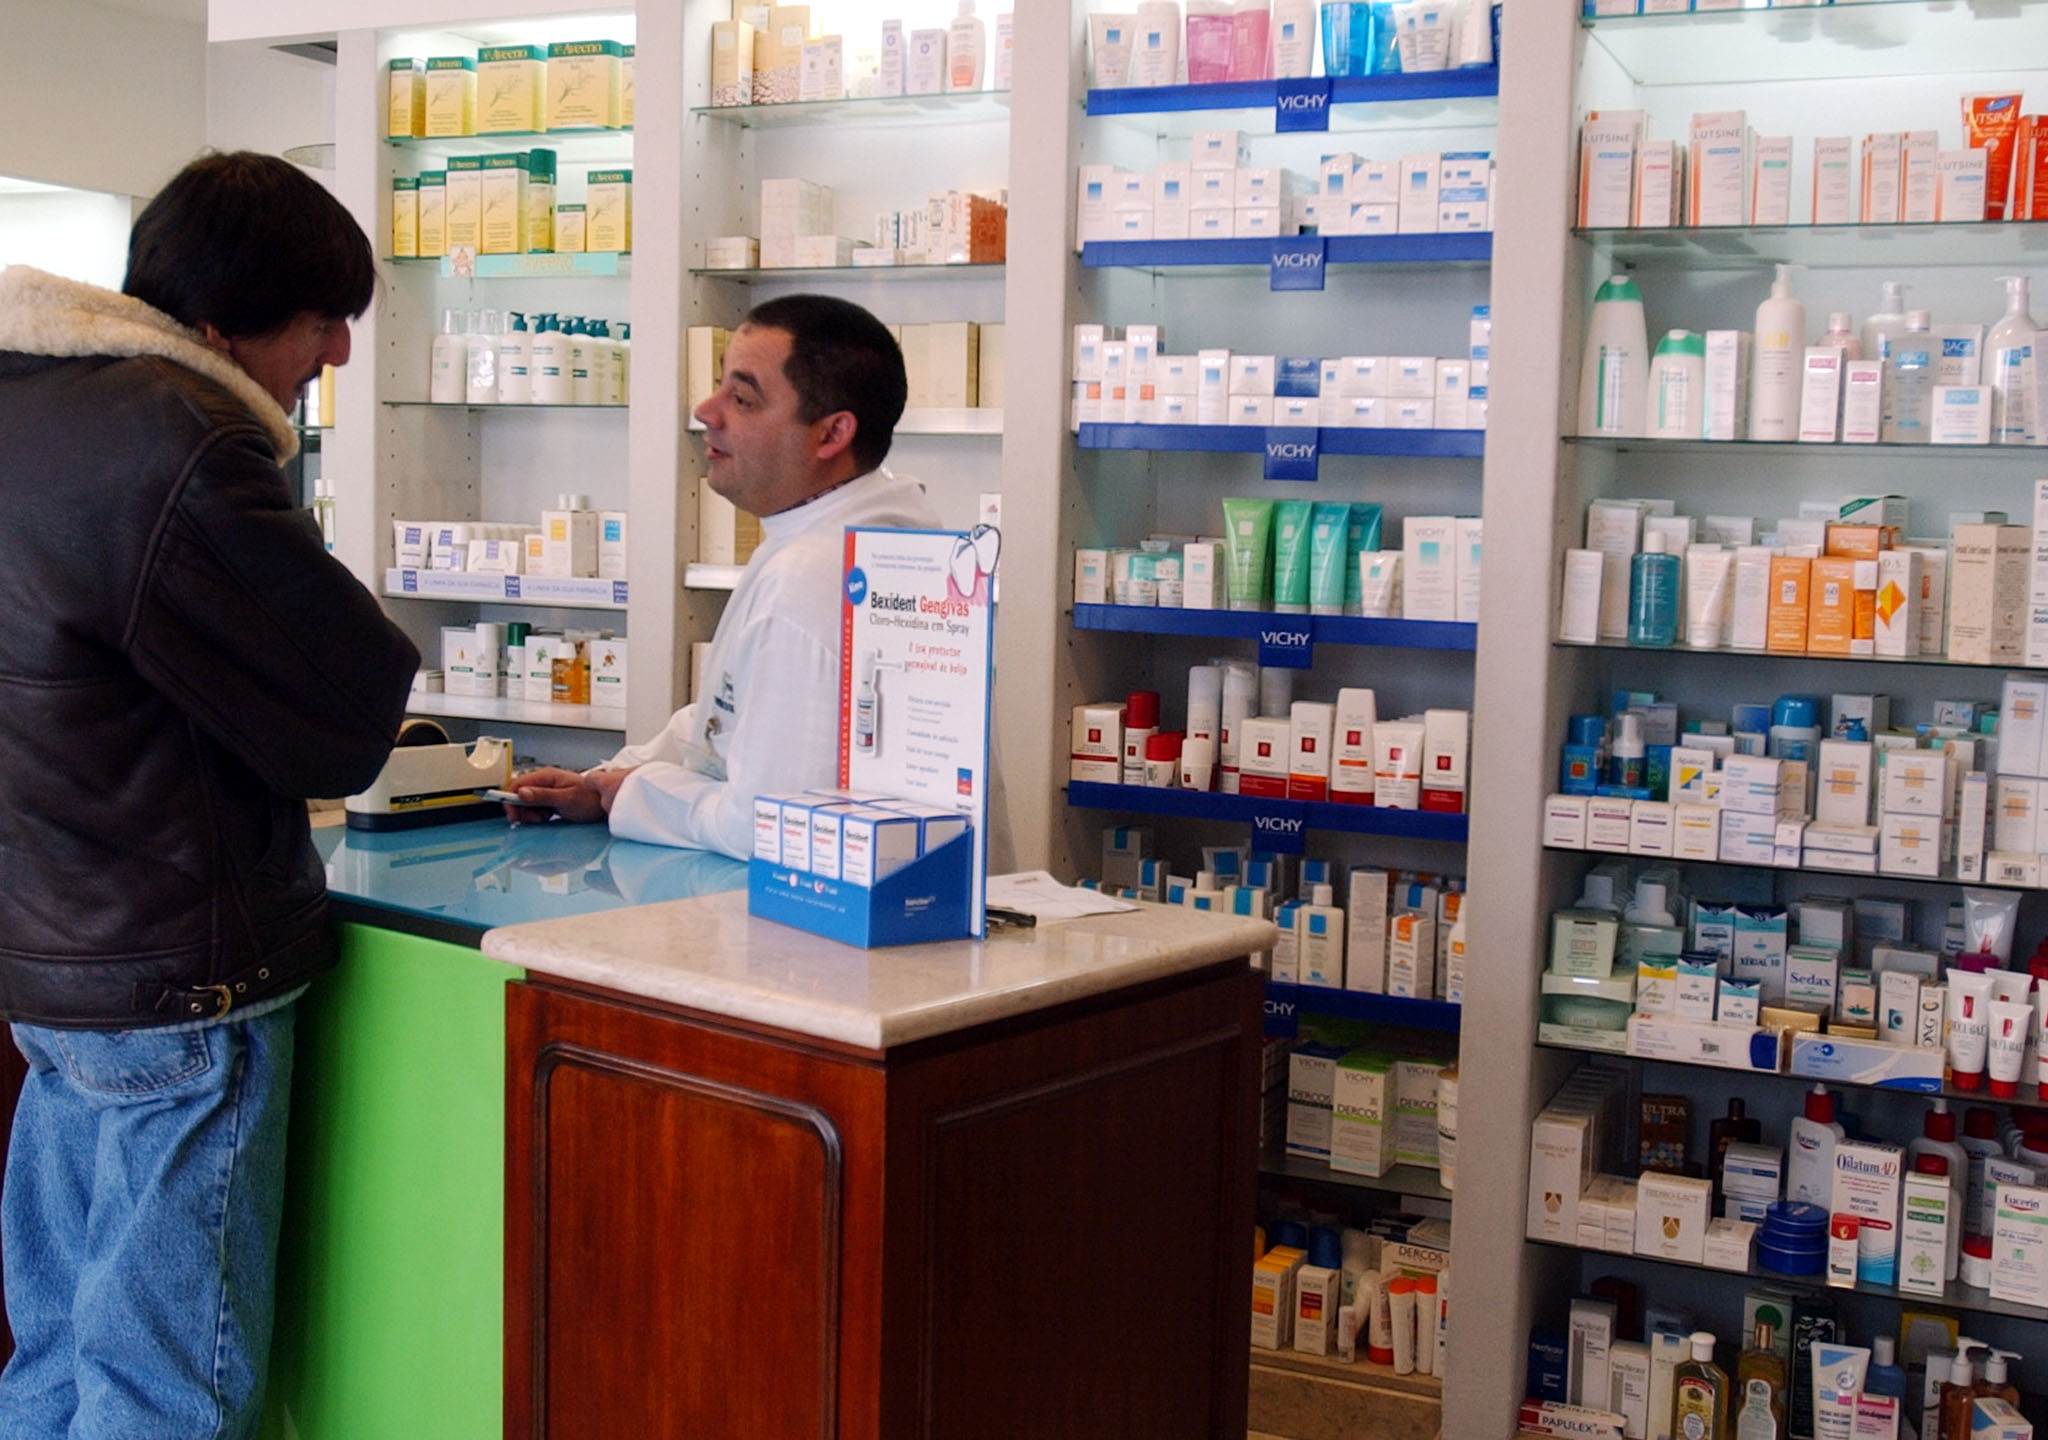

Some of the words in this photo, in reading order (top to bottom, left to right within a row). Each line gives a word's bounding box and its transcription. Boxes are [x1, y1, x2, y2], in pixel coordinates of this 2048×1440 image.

[1278, 94, 1328, 110] VICHY
[1585, 133, 1631, 144] LUTSINE
[1694, 129, 1743, 139] LUTSINE
[1937, 160, 1985, 170] LUTSINE
[1273, 253, 1322, 269] VICHY
[1267, 444, 1316, 458] VICHY
[1415, 528, 1446, 537] VICHY
[1466, 530, 1483, 539] VIC
[870, 592, 917, 613] Bexident
[919, 595, 970, 620] Gengivas
[869, 613, 929, 631] Cloro-Hexidina
[930, 620, 944, 632] em
[946, 620, 970, 638] Spray
[1261, 631, 1310, 646] VICHY
[1254, 815, 1303, 833] VICHY
[1790, 972, 1832, 987] Sedax
[1264, 1001, 1296, 1016] CHY
[1298, 1059, 1327, 1070] VICHY
[1406, 1065, 1436, 1077] VICHY
[1344, 1072, 1375, 1084] VICHY
[1291, 1089, 1331, 1102] DERCOS
[1400, 1098, 1437, 1110] DERCO
[1336, 1104, 1379, 1120] DERCOS
[1836, 1154, 1880, 1174] Oilatum
[1881, 1161, 1898, 1177] AD
[1990, 1166, 2019, 1183] Eucerin
[2004, 1193, 2040, 1209] Eucerin
[1398, 1246, 1445, 1264] DERCOS
[1541, 1416, 1594, 1433] PAPULEX
